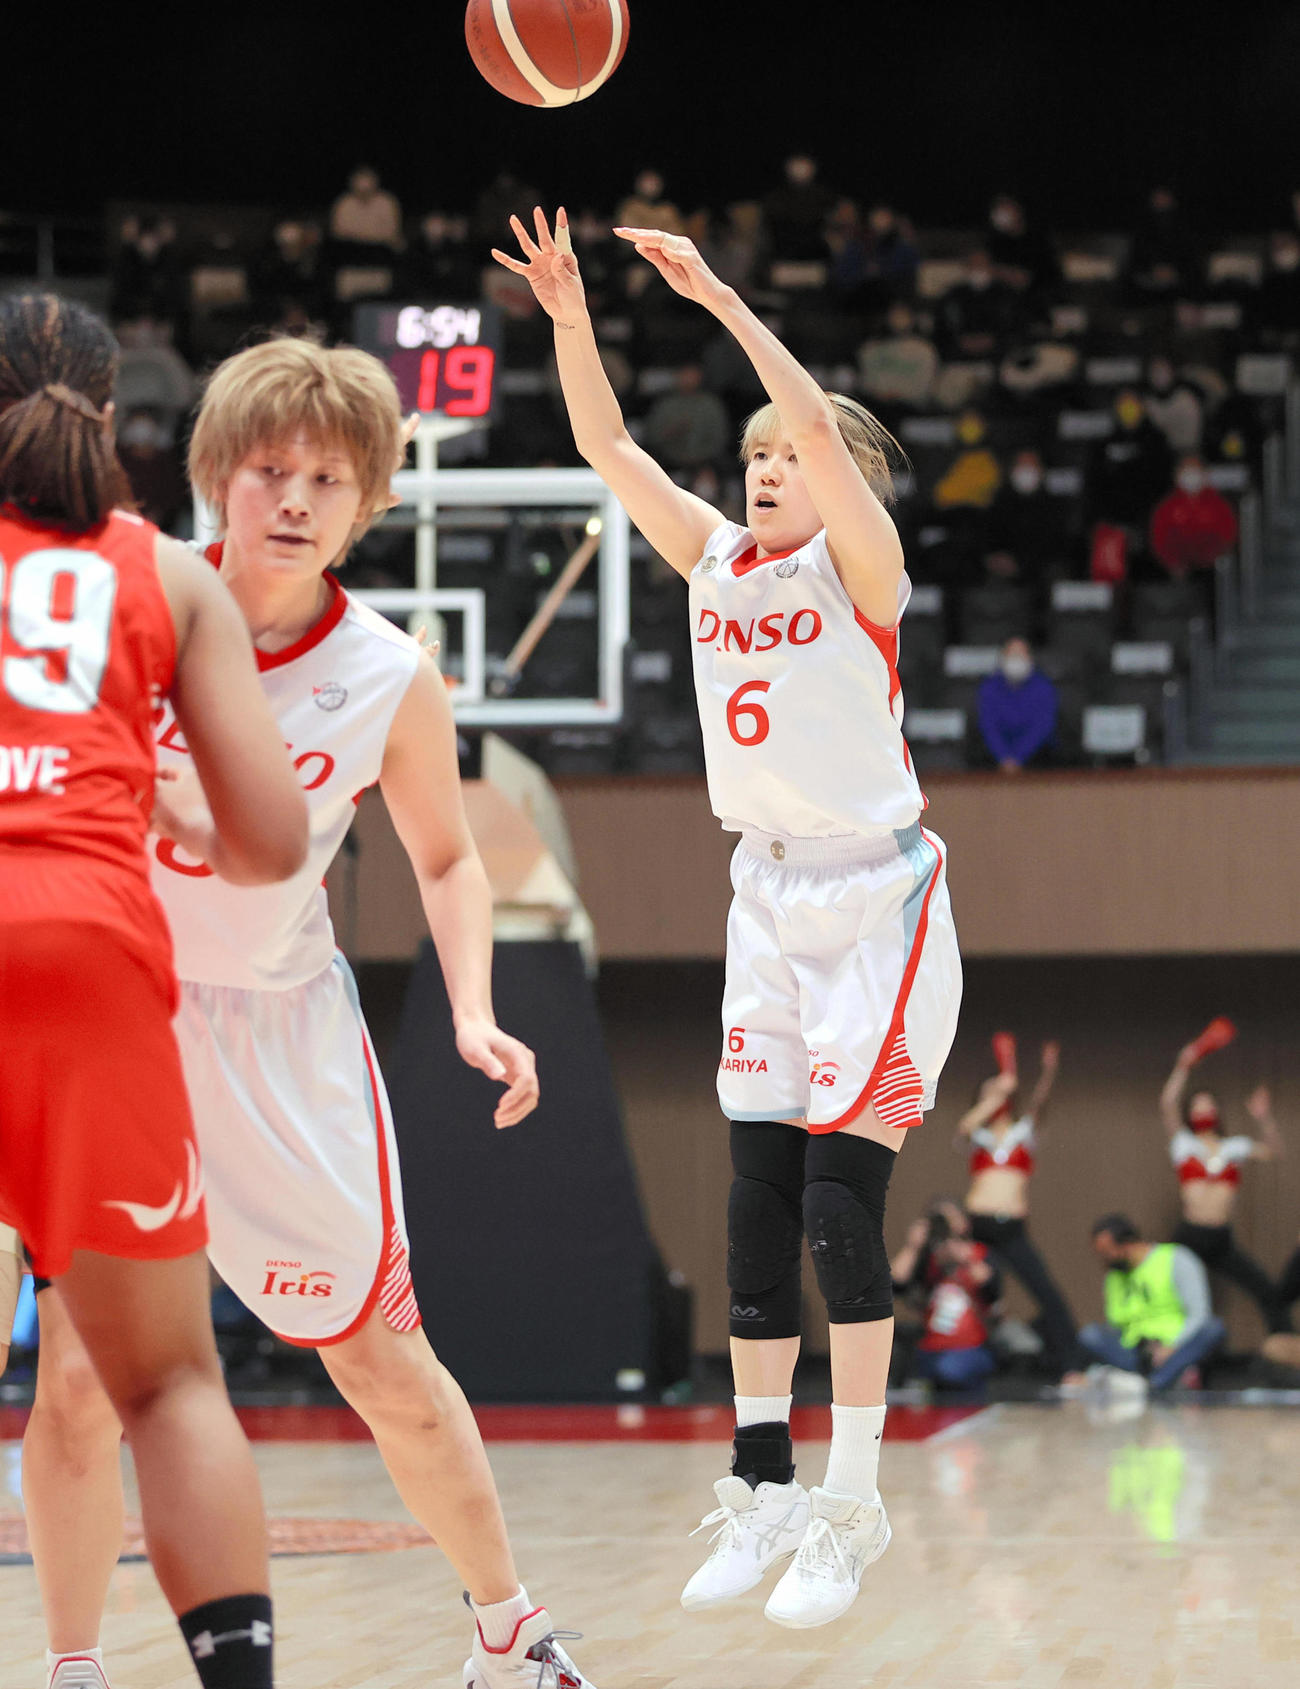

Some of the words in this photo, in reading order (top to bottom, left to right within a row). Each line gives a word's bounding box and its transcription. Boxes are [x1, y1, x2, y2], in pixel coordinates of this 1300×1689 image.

[417, 346, 495, 417] 19
[0, 548, 117, 714] 9
[697, 608, 823, 654] DNSO
[726, 680, 771, 747] 6
[728, 1027, 746, 1053] 6
[259, 1271, 333, 1297] Iris
[265, 1259, 302, 1269] DENSO
